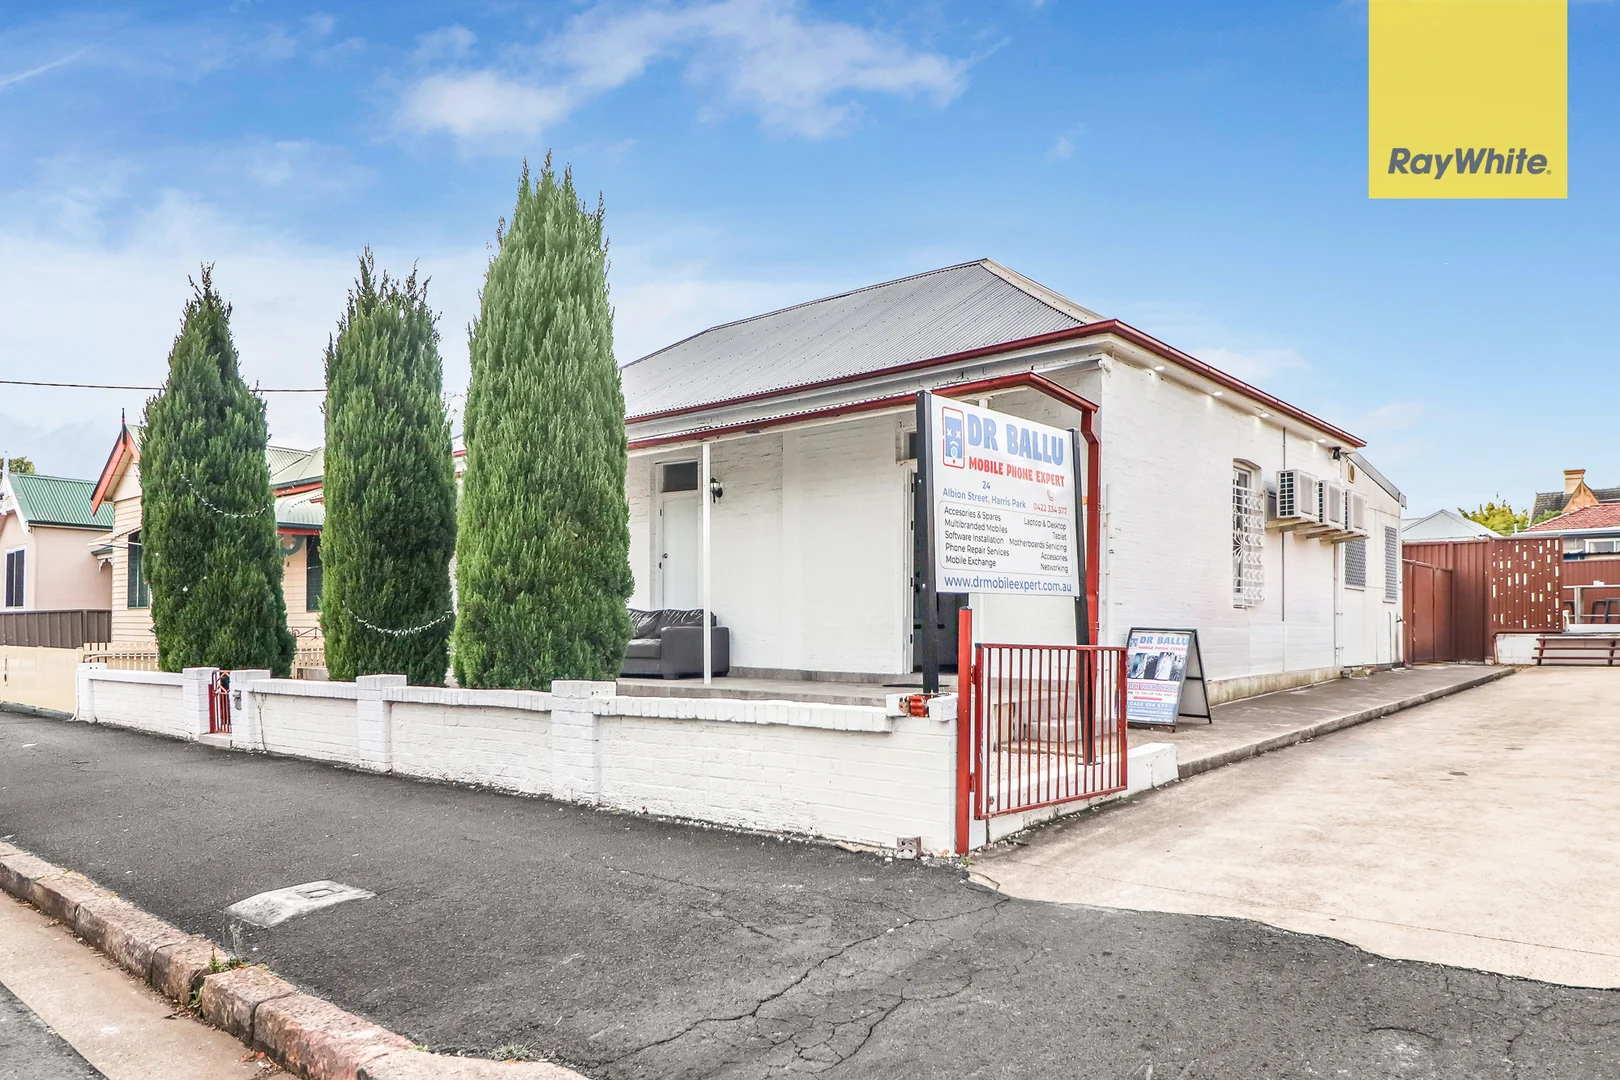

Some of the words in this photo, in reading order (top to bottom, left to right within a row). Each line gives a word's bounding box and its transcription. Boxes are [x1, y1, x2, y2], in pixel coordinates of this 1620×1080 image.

[967, 413, 999, 451] DR
[1006, 423, 1064, 466] BALLU
[969, 456, 1003, 476] MOBILE
[1006, 464, 1033, 481] PHONE
[1036, 470, 1065, 487] EXPERT
[982, 481, 991, 490] 24
[943, 488, 966, 499] Albion
[967, 491, 990, 504] Street,
[992, 495, 1011, 506] Harris
[1012, 499, 1026, 508] Park
[944, 506, 976, 519] Accesories
[977, 511, 981, 519] &
[982, 511, 1001, 521] Spares
[1033, 503, 1047, 512] 0422
[1047, 505, 1057, 513] 334
[1058, 507, 1067, 515] 577
[944, 518, 985, 531] Multibranded
[986, 524, 1008, 534] Mobiles
[1024, 518, 1041, 528] Laptop
[1042, 520, 1046, 528] &
[1047, 520, 1067, 531] Desktop
[945, 530, 972, 541] Software
[973, 534, 1004, 544] Installation
[1052, 531, 1067, 541] Tablet
[945, 542, 966, 552] Phone
[967, 544, 986, 555] Repair
[987, 546, 1010, 556] Services
[1009, 538, 1045, 549] Motherboards
[1046, 541, 1067, 553] Servicing
[945, 555, 967, 565] Mobile
[968, 556, 996, 568] Exchange
[1041, 552, 1068, 562] Accessories
[1040, 563, 1069, 574] Networking
[944, 575, 1072, 593] www.drmobileexpert.com.au
[1140, 636, 1154, 645] DR
[1157, 636, 1189, 646] BALLU
